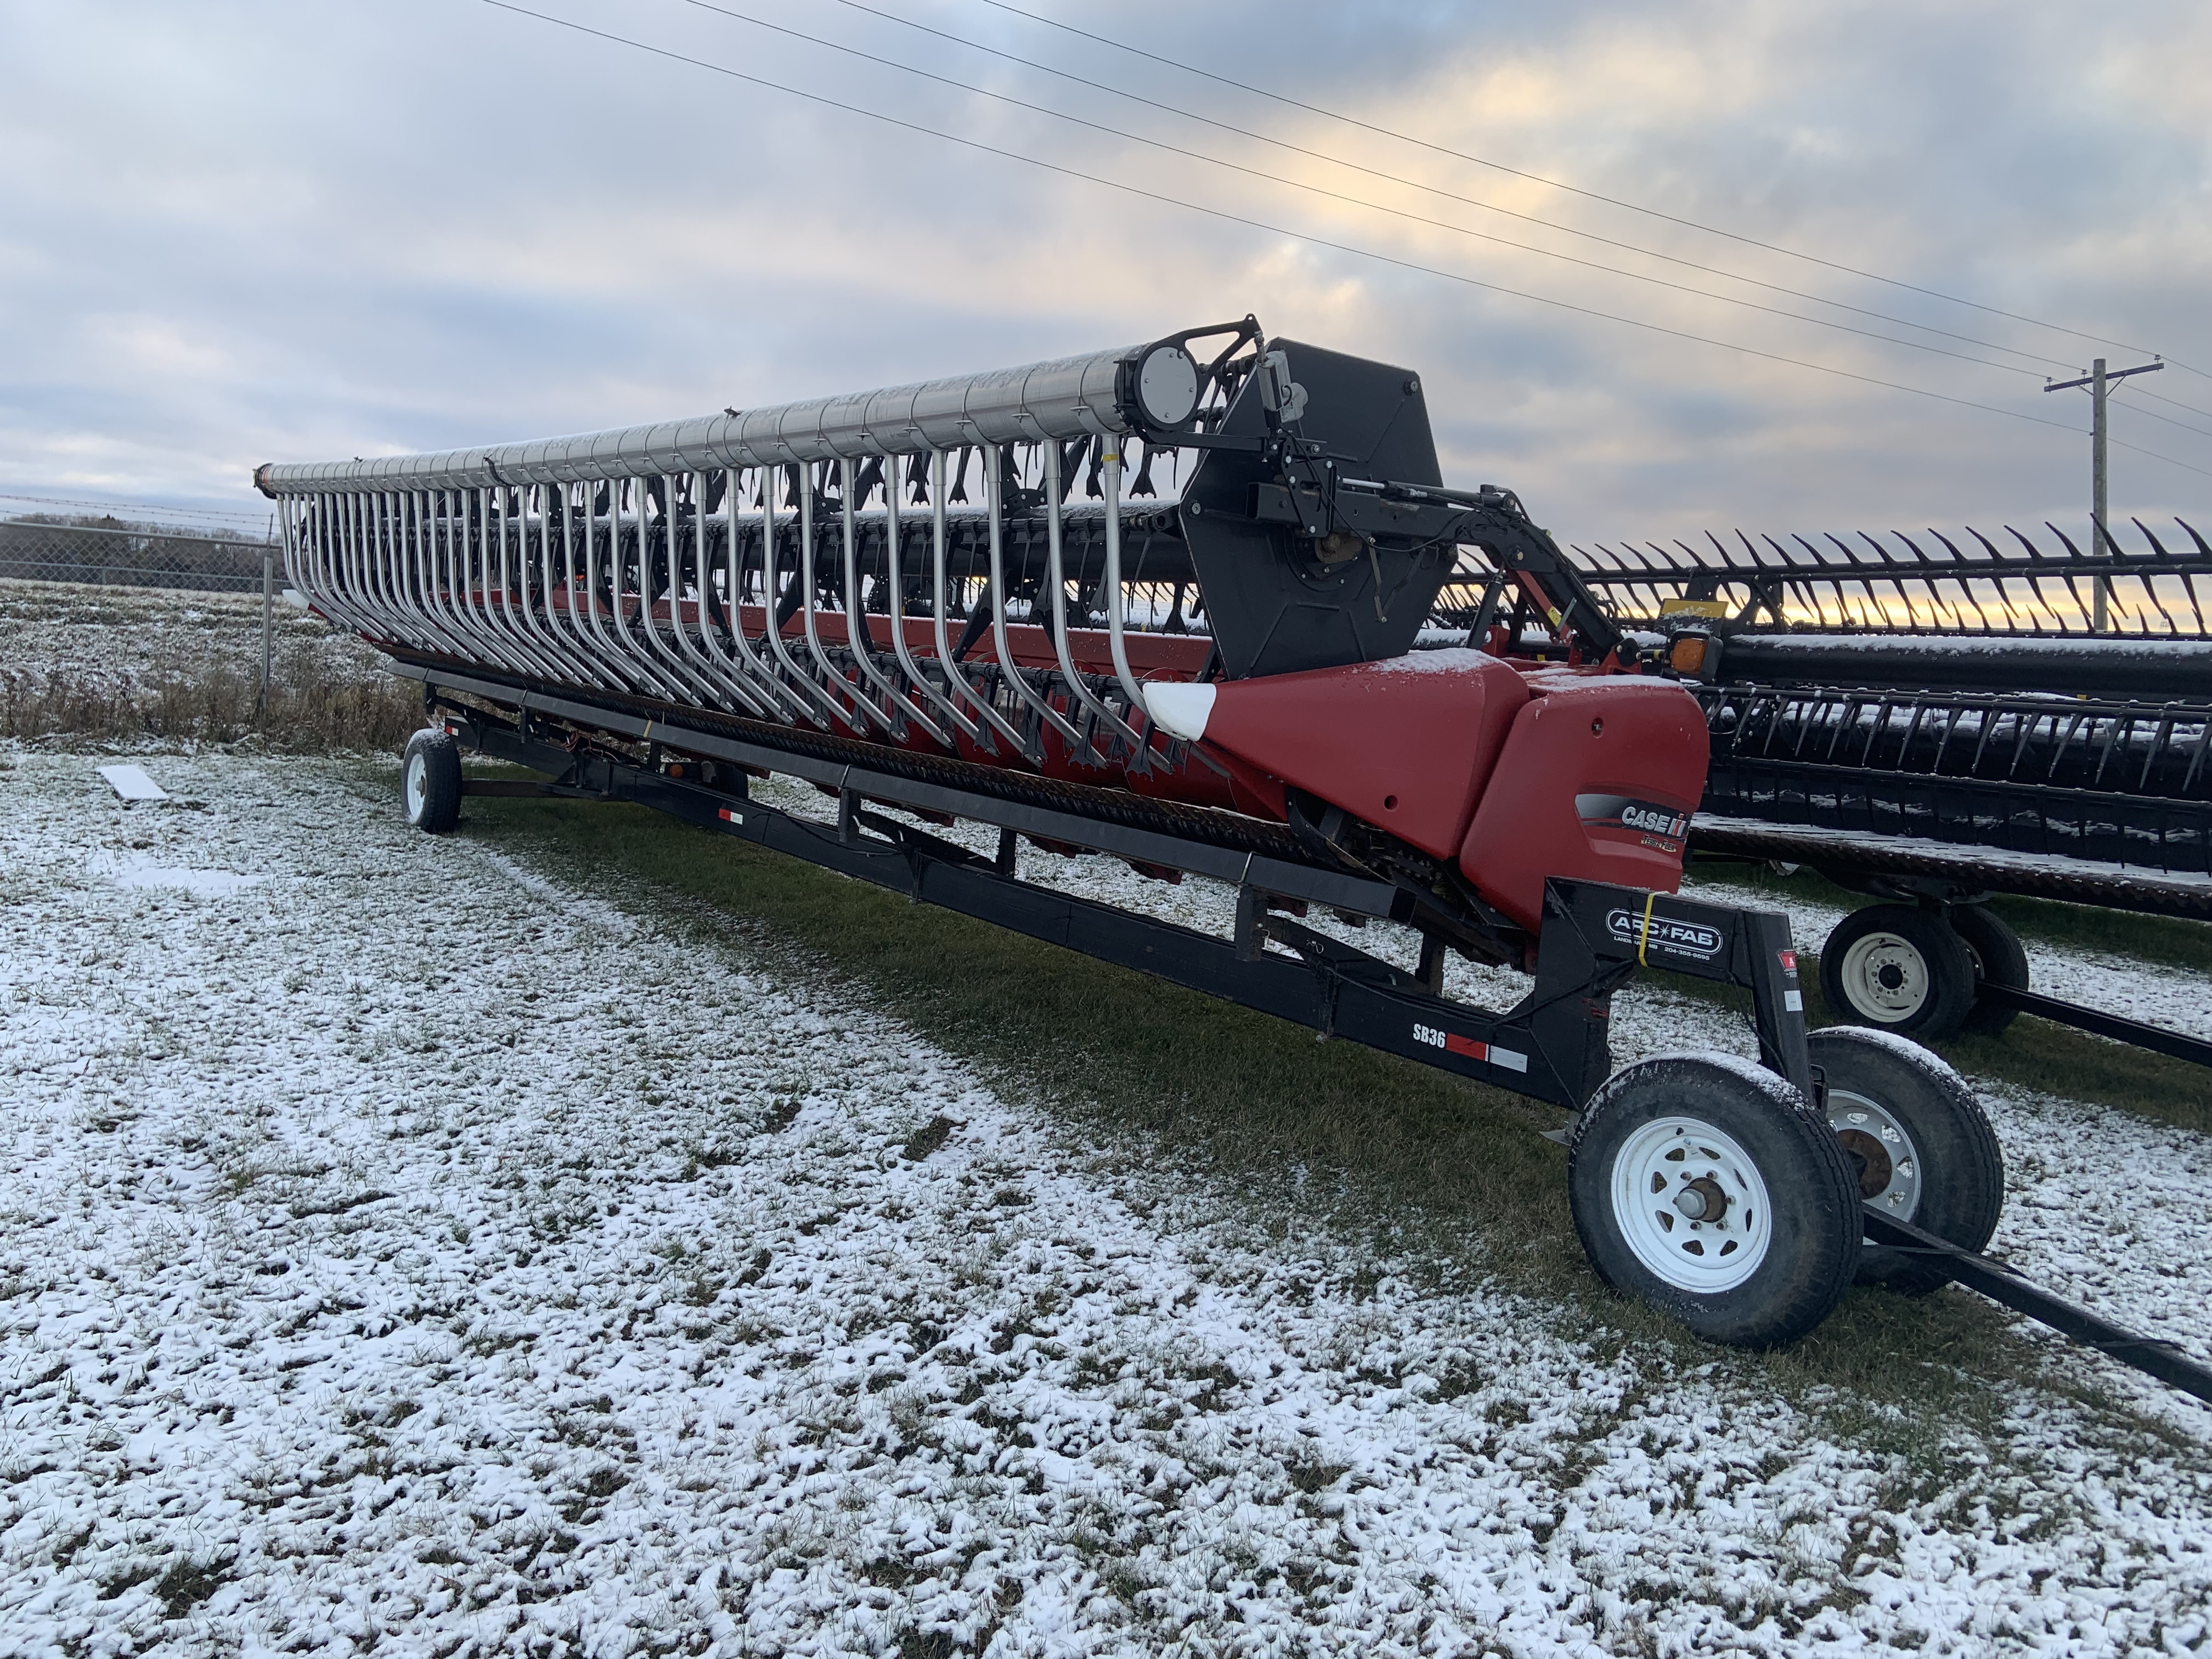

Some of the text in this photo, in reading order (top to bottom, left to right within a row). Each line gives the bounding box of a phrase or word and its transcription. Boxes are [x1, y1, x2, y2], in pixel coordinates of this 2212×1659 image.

[1615, 917, 1713, 946] ARC FAB
[1664, 947, 1710, 961] 204-355-9595
[1413, 1023, 1446, 1048] SB36
